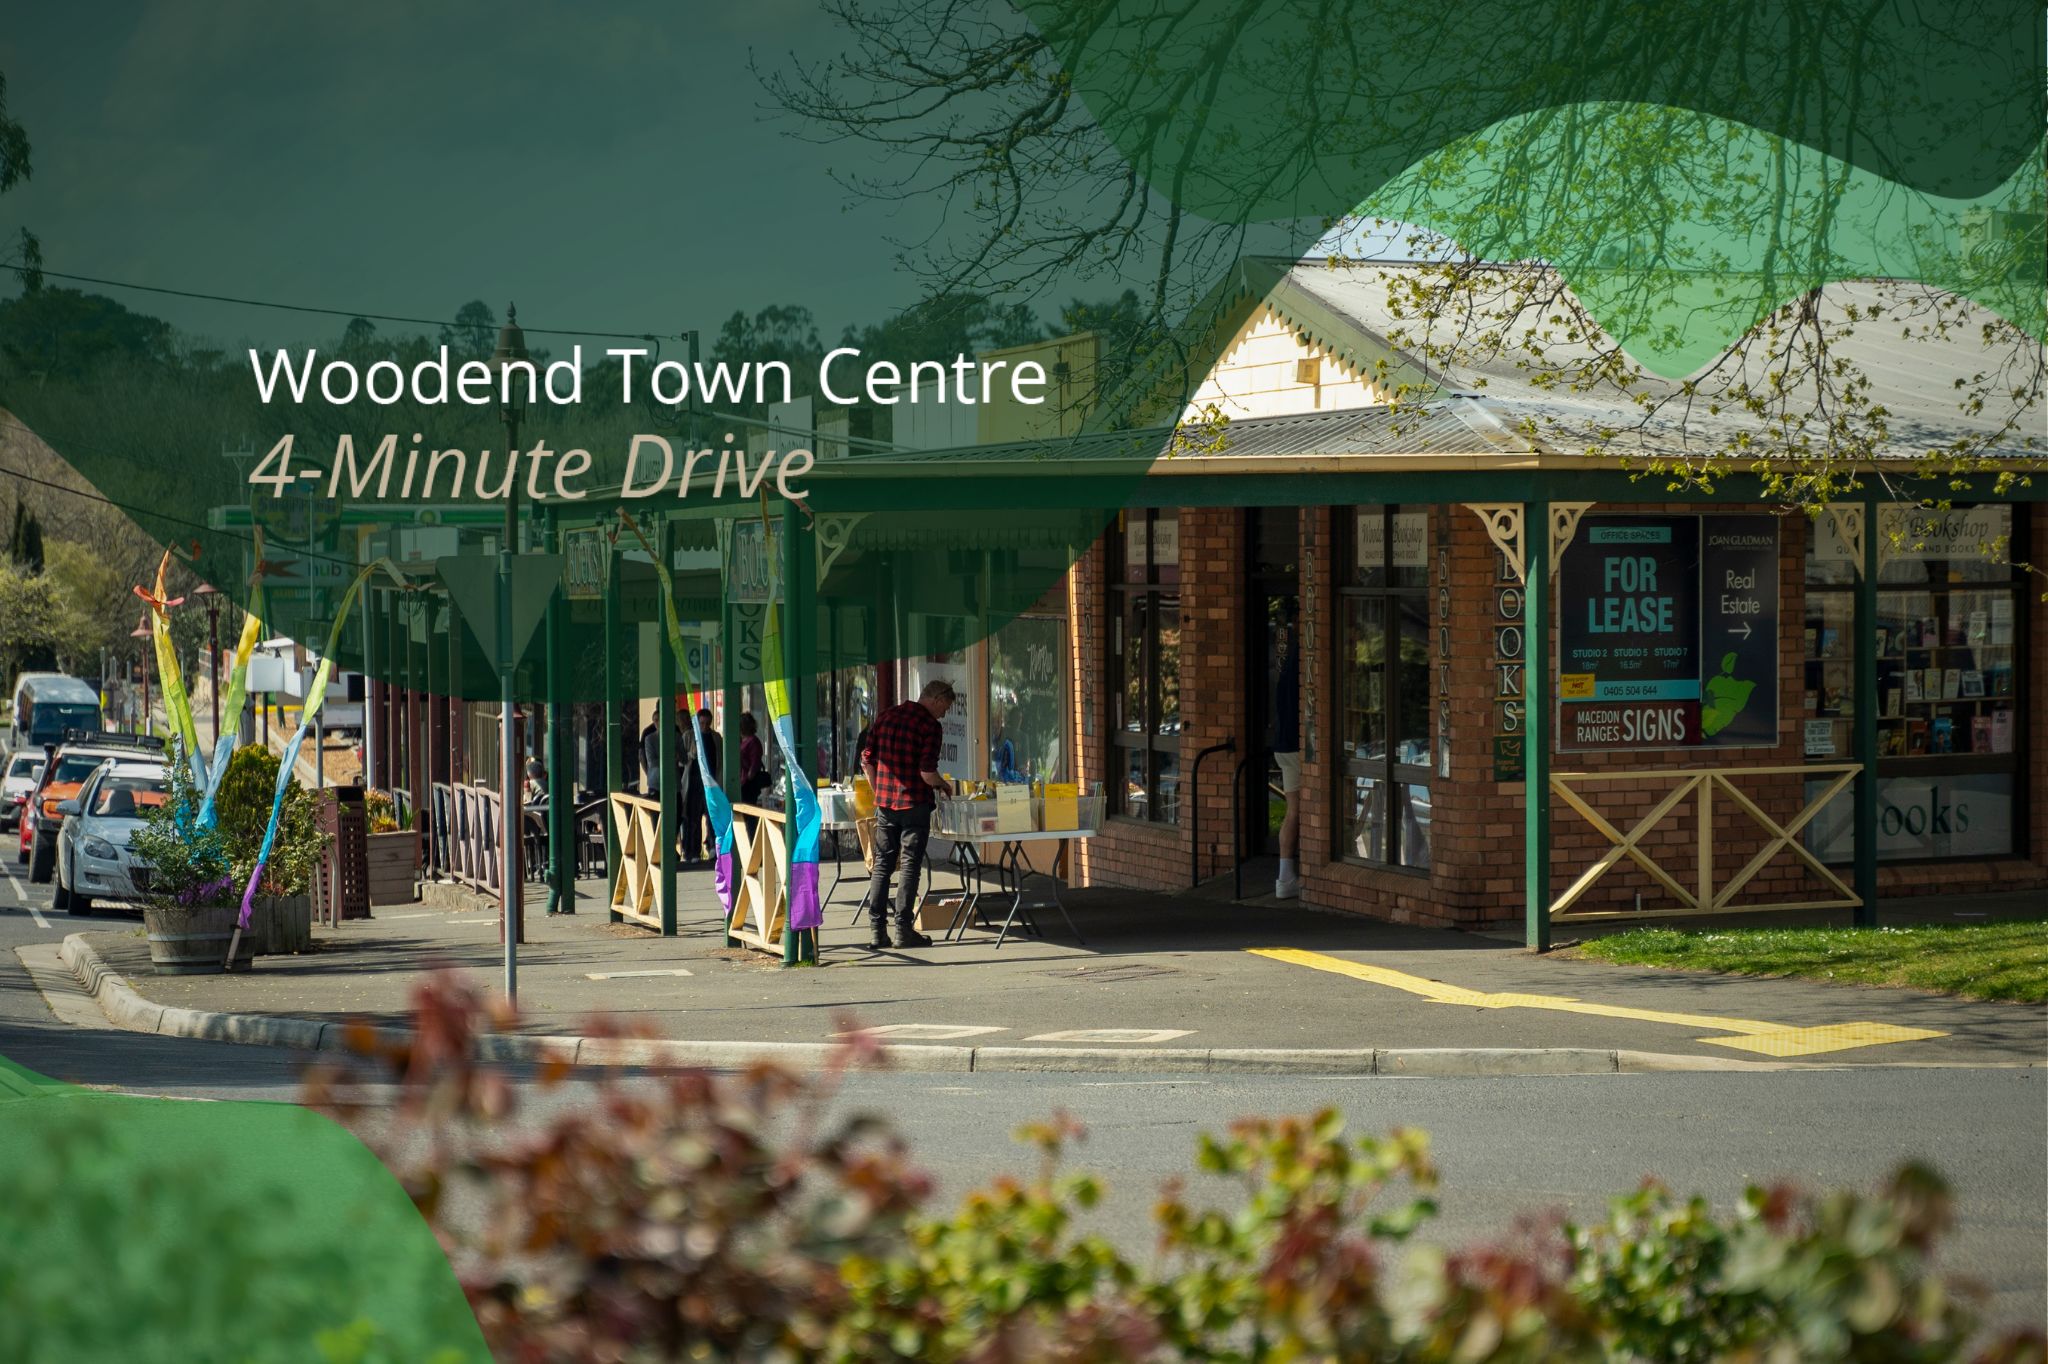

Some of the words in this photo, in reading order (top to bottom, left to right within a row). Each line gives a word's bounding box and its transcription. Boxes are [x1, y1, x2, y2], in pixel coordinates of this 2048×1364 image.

[1600, 531, 1629, 540] OFFICE
[1631, 530, 1661, 540] SPACES
[1708, 536, 1730, 546] JOAN
[1730, 535, 1774, 545] GLADMAN
[307, 562, 342, 577] hub
[1604, 556, 1657, 593] FOR
[1726, 568, 1755, 589] Real
[1721, 594, 1761, 614] Estate
[1588, 597, 1674, 634] LEASE
[1305, 551, 1315, 716] BOOKS
[1440, 551, 1450, 731] BOOKS
[1498, 549, 1522, 732] BOOKS
[1572, 649, 1601, 658] STUDIO
[1602, 648, 1608, 658] 2
[1614, 648, 1642, 657] STUDIO
[1654, 648, 1682, 657] STUDIO
[1682, 647, 1688, 656] 7
[1604, 687, 1624, 697] 0405
[1577, 710, 1620, 724] MACEDON
[1622, 708, 1686, 741] SIGNS
[1577, 726, 1620, 742] RANGES
[1850, 785, 1970, 836] ooks
